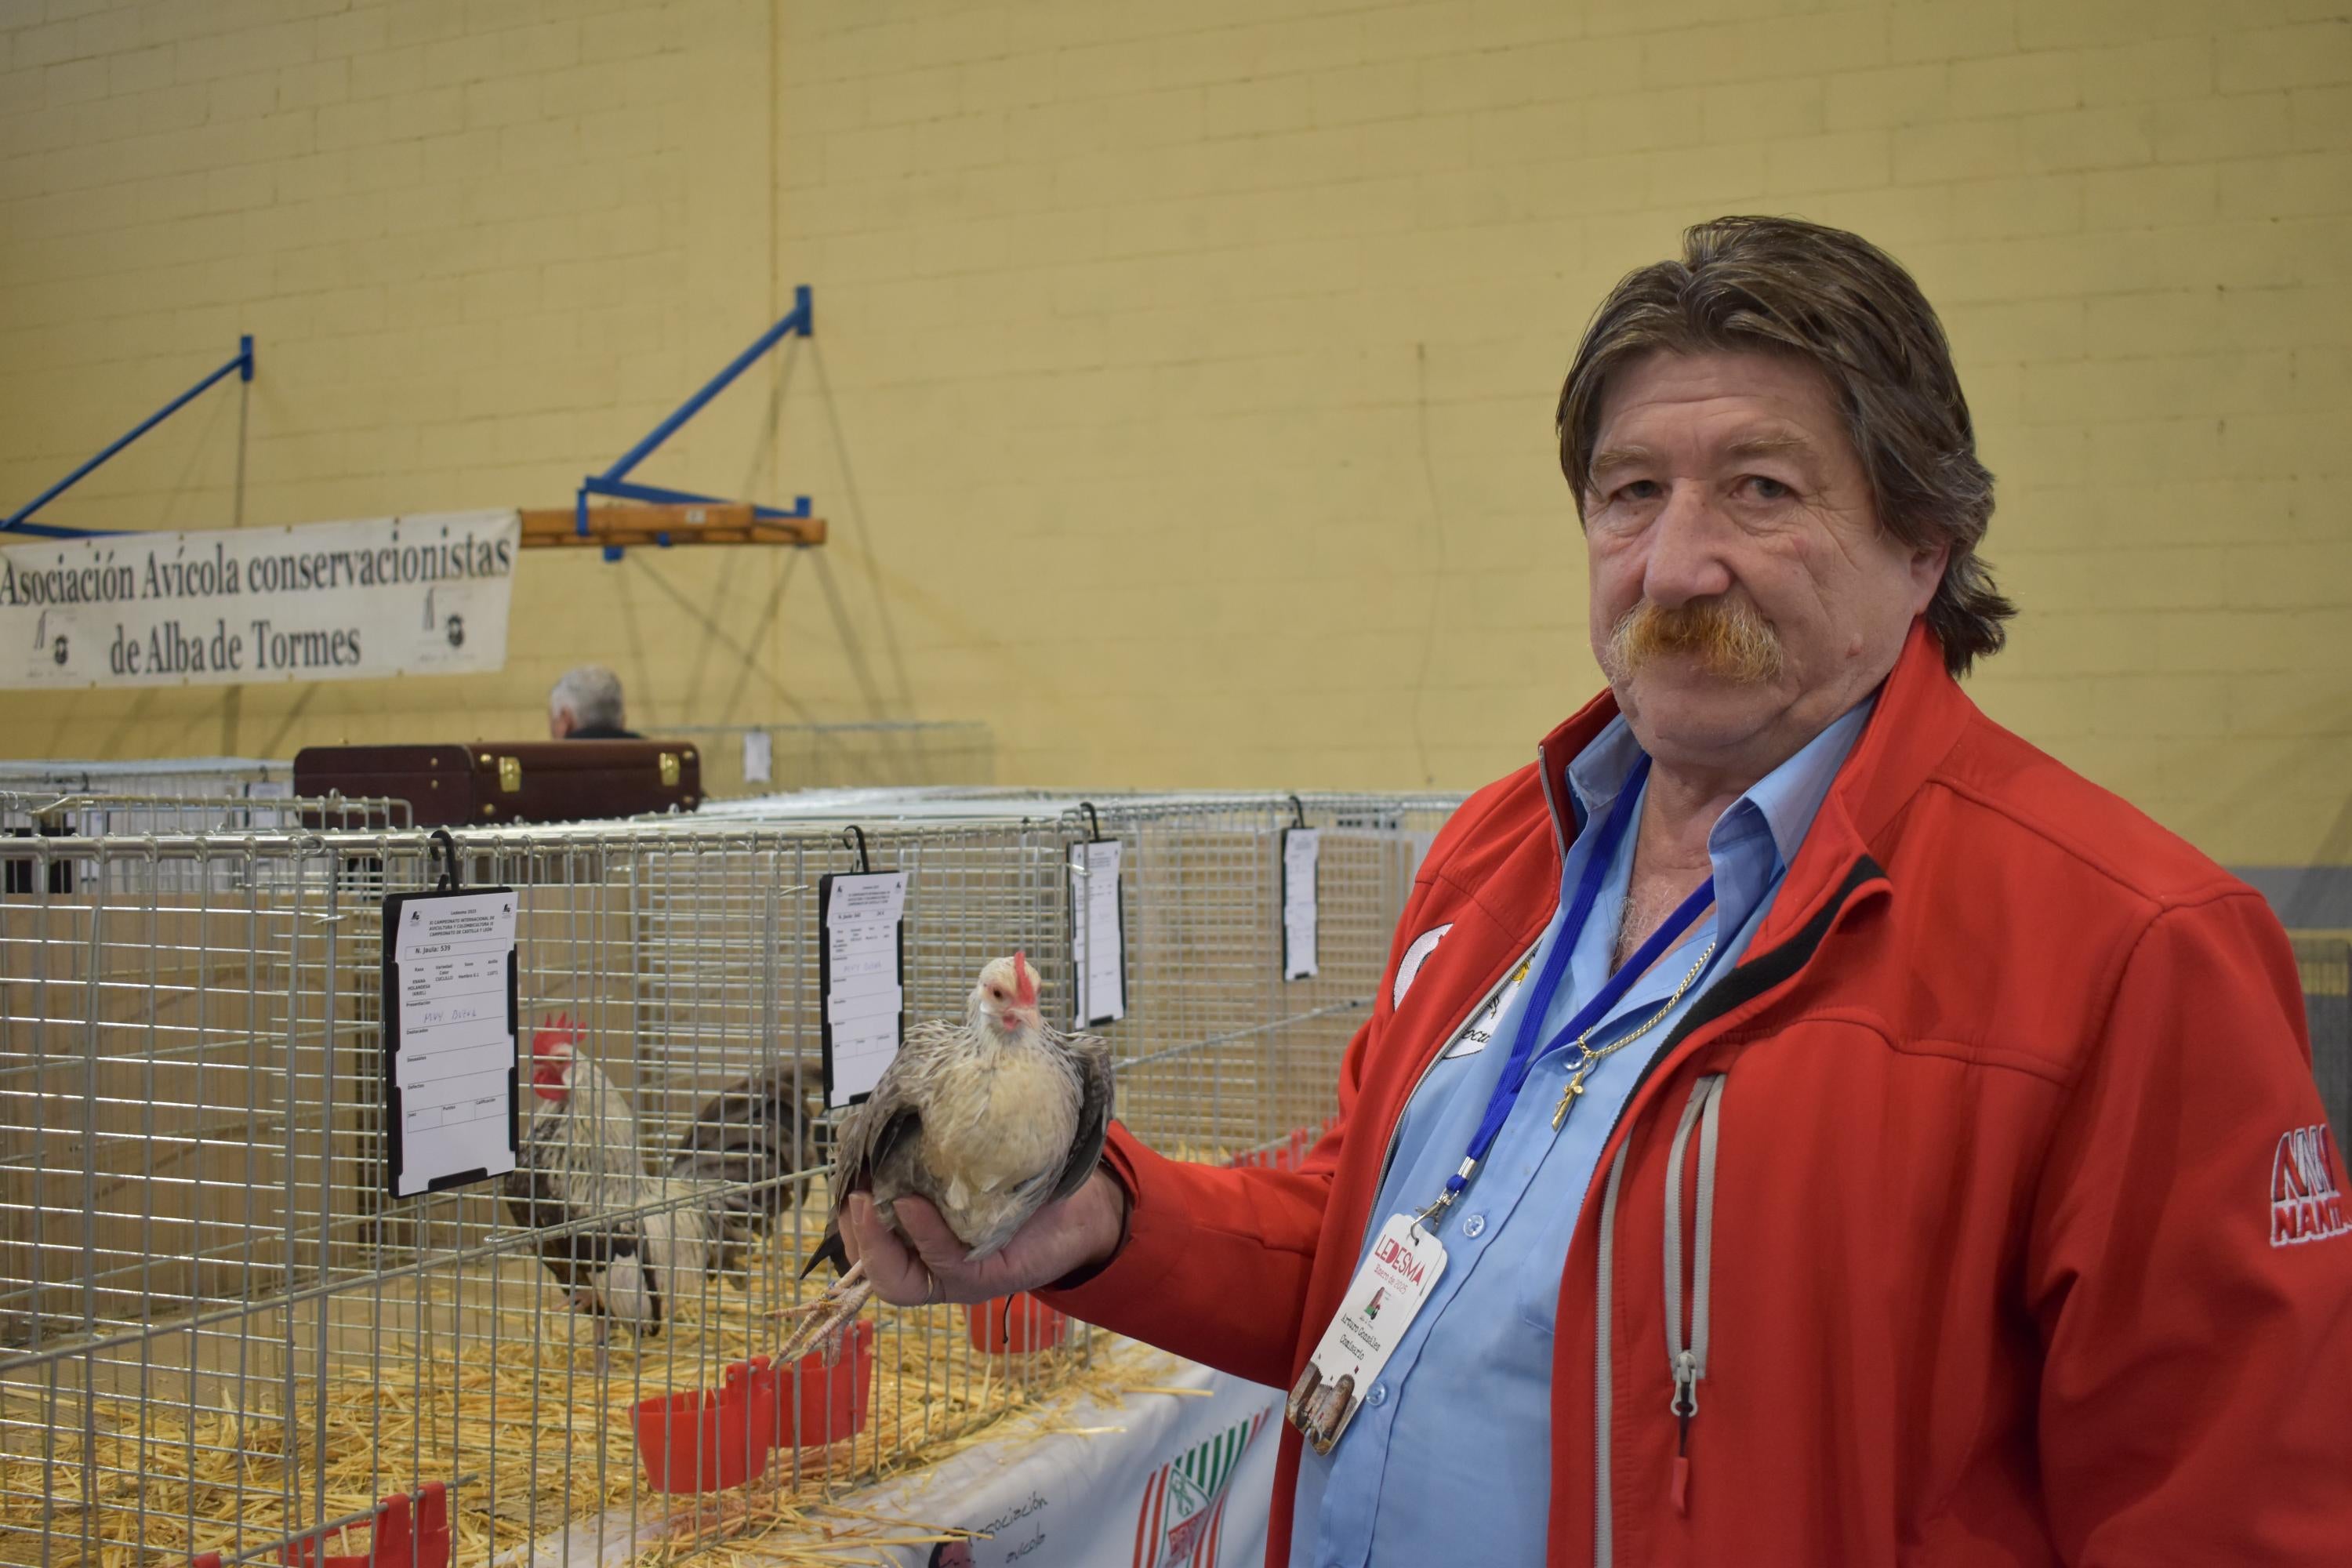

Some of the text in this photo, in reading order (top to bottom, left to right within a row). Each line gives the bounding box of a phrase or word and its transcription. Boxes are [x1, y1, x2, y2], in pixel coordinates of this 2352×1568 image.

[0, 524, 511, 607] Asociación Avícola conservacionistas
[111, 618, 361, 675] de Alba de Tormes
[422, 946, 439, 954] Jaula:
[2270, 1198, 2352, 1249] NANT
[1374, 1233, 1425, 1287] LEDESMA
[1374, 1263, 1390, 1280] Enero
[1392, 1279, 1409, 1295] 2025
[1341, 1312, 1359, 1333] Arturo
[1339, 1334, 1365, 1360] Comisario
